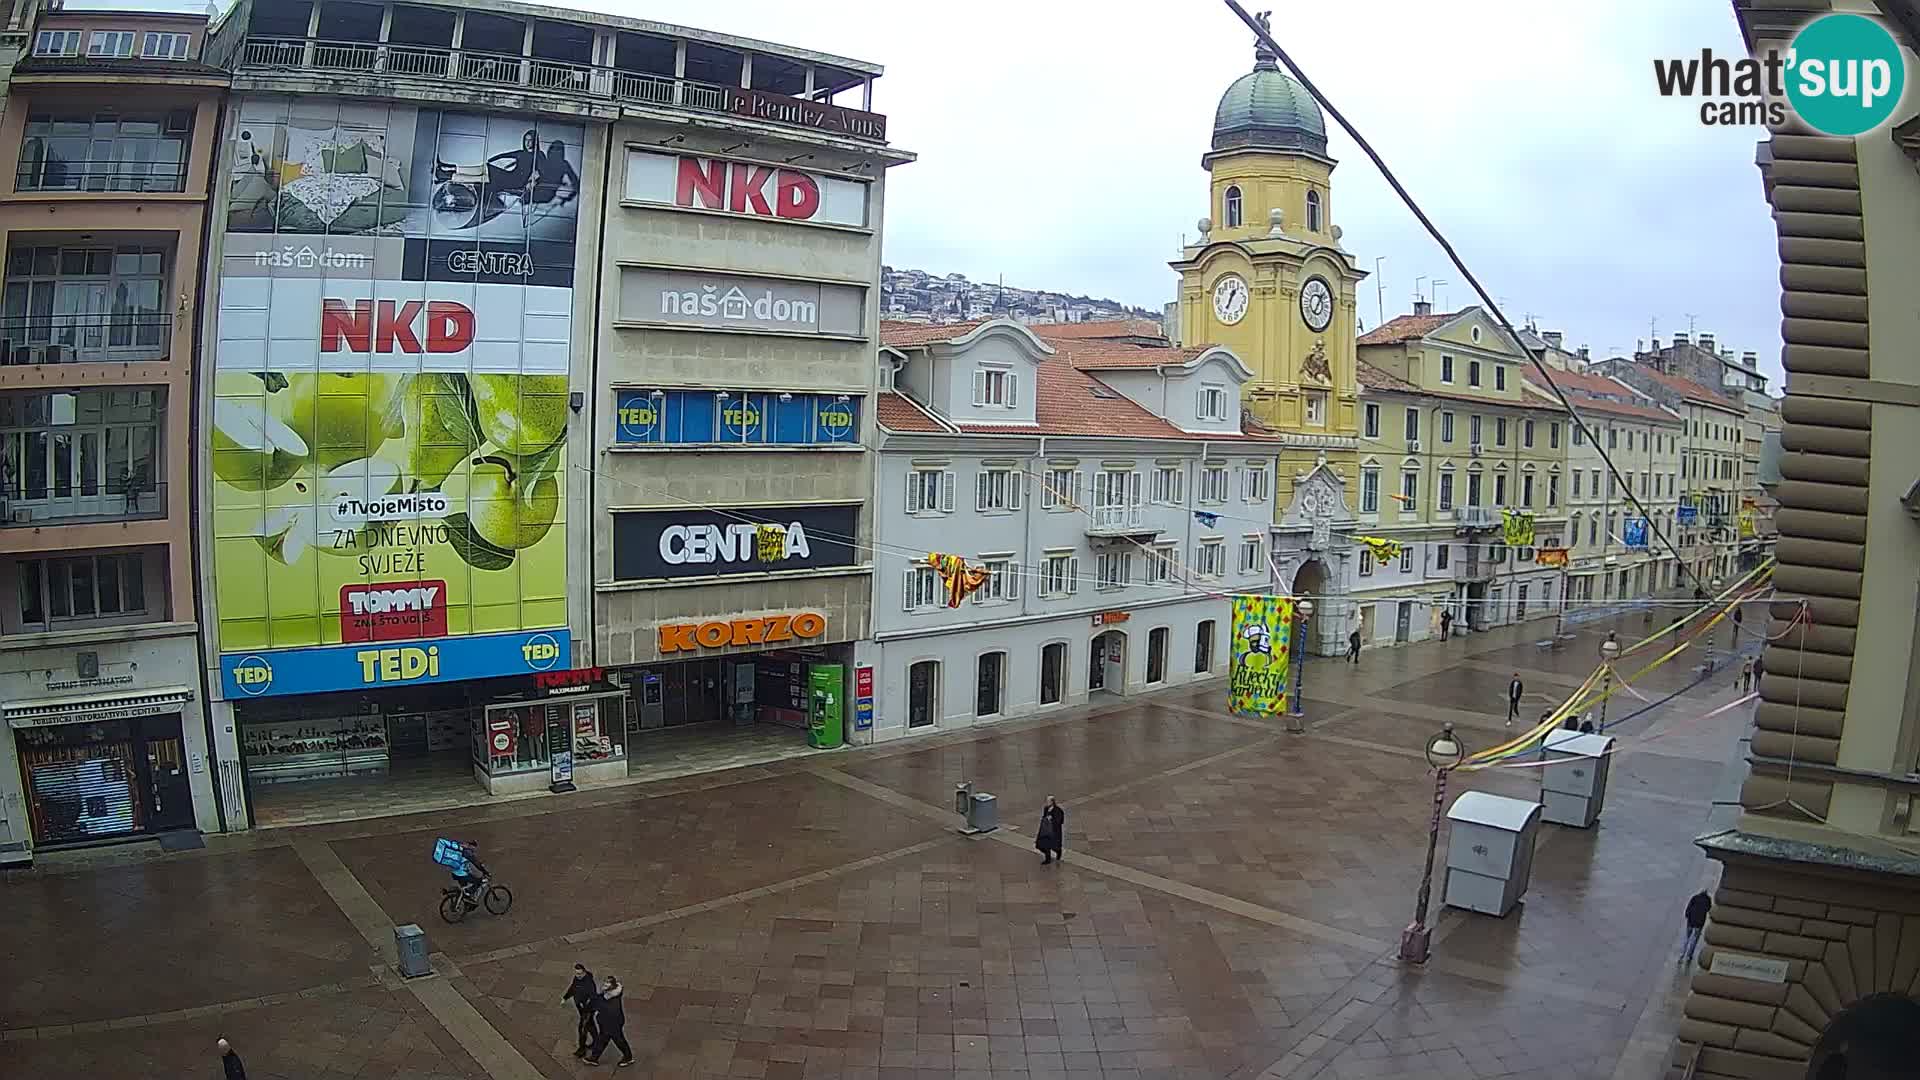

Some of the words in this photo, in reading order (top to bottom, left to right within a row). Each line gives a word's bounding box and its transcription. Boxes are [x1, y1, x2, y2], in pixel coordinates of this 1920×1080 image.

[678, 158, 821, 221] NKD
[255, 247, 294, 267] naš
[318, 248, 365, 269] dom
[448, 250, 535, 276] CENTRA
[661, 284, 718, 317] naš
[755, 290, 817, 323] dom
[321, 298, 476, 354] NKD
[618, 408, 658, 427] TEDi
[723, 409, 760, 426] TEDi
[819, 411, 853, 428] TEDi
[338, 496, 446, 517] #TvojeMisto
[333, 529, 357, 549] ZA
[367, 524, 450, 547] DNEVNO
[659, 521, 810, 565] CENTA
[359, 548, 427, 576] SVJEŽE
[348, 586, 439, 615] TOMMY
[379, 616, 400, 626] ŠTO
[658, 612, 826, 653] KORZO
[522, 642, 560, 661] TEDi
[233, 668, 273, 685] TEDi
[357, 647, 440, 683] TEDi
[548, 685, 590, 695] MAXIMARKET
[132, 707, 161, 716] CENTAR
